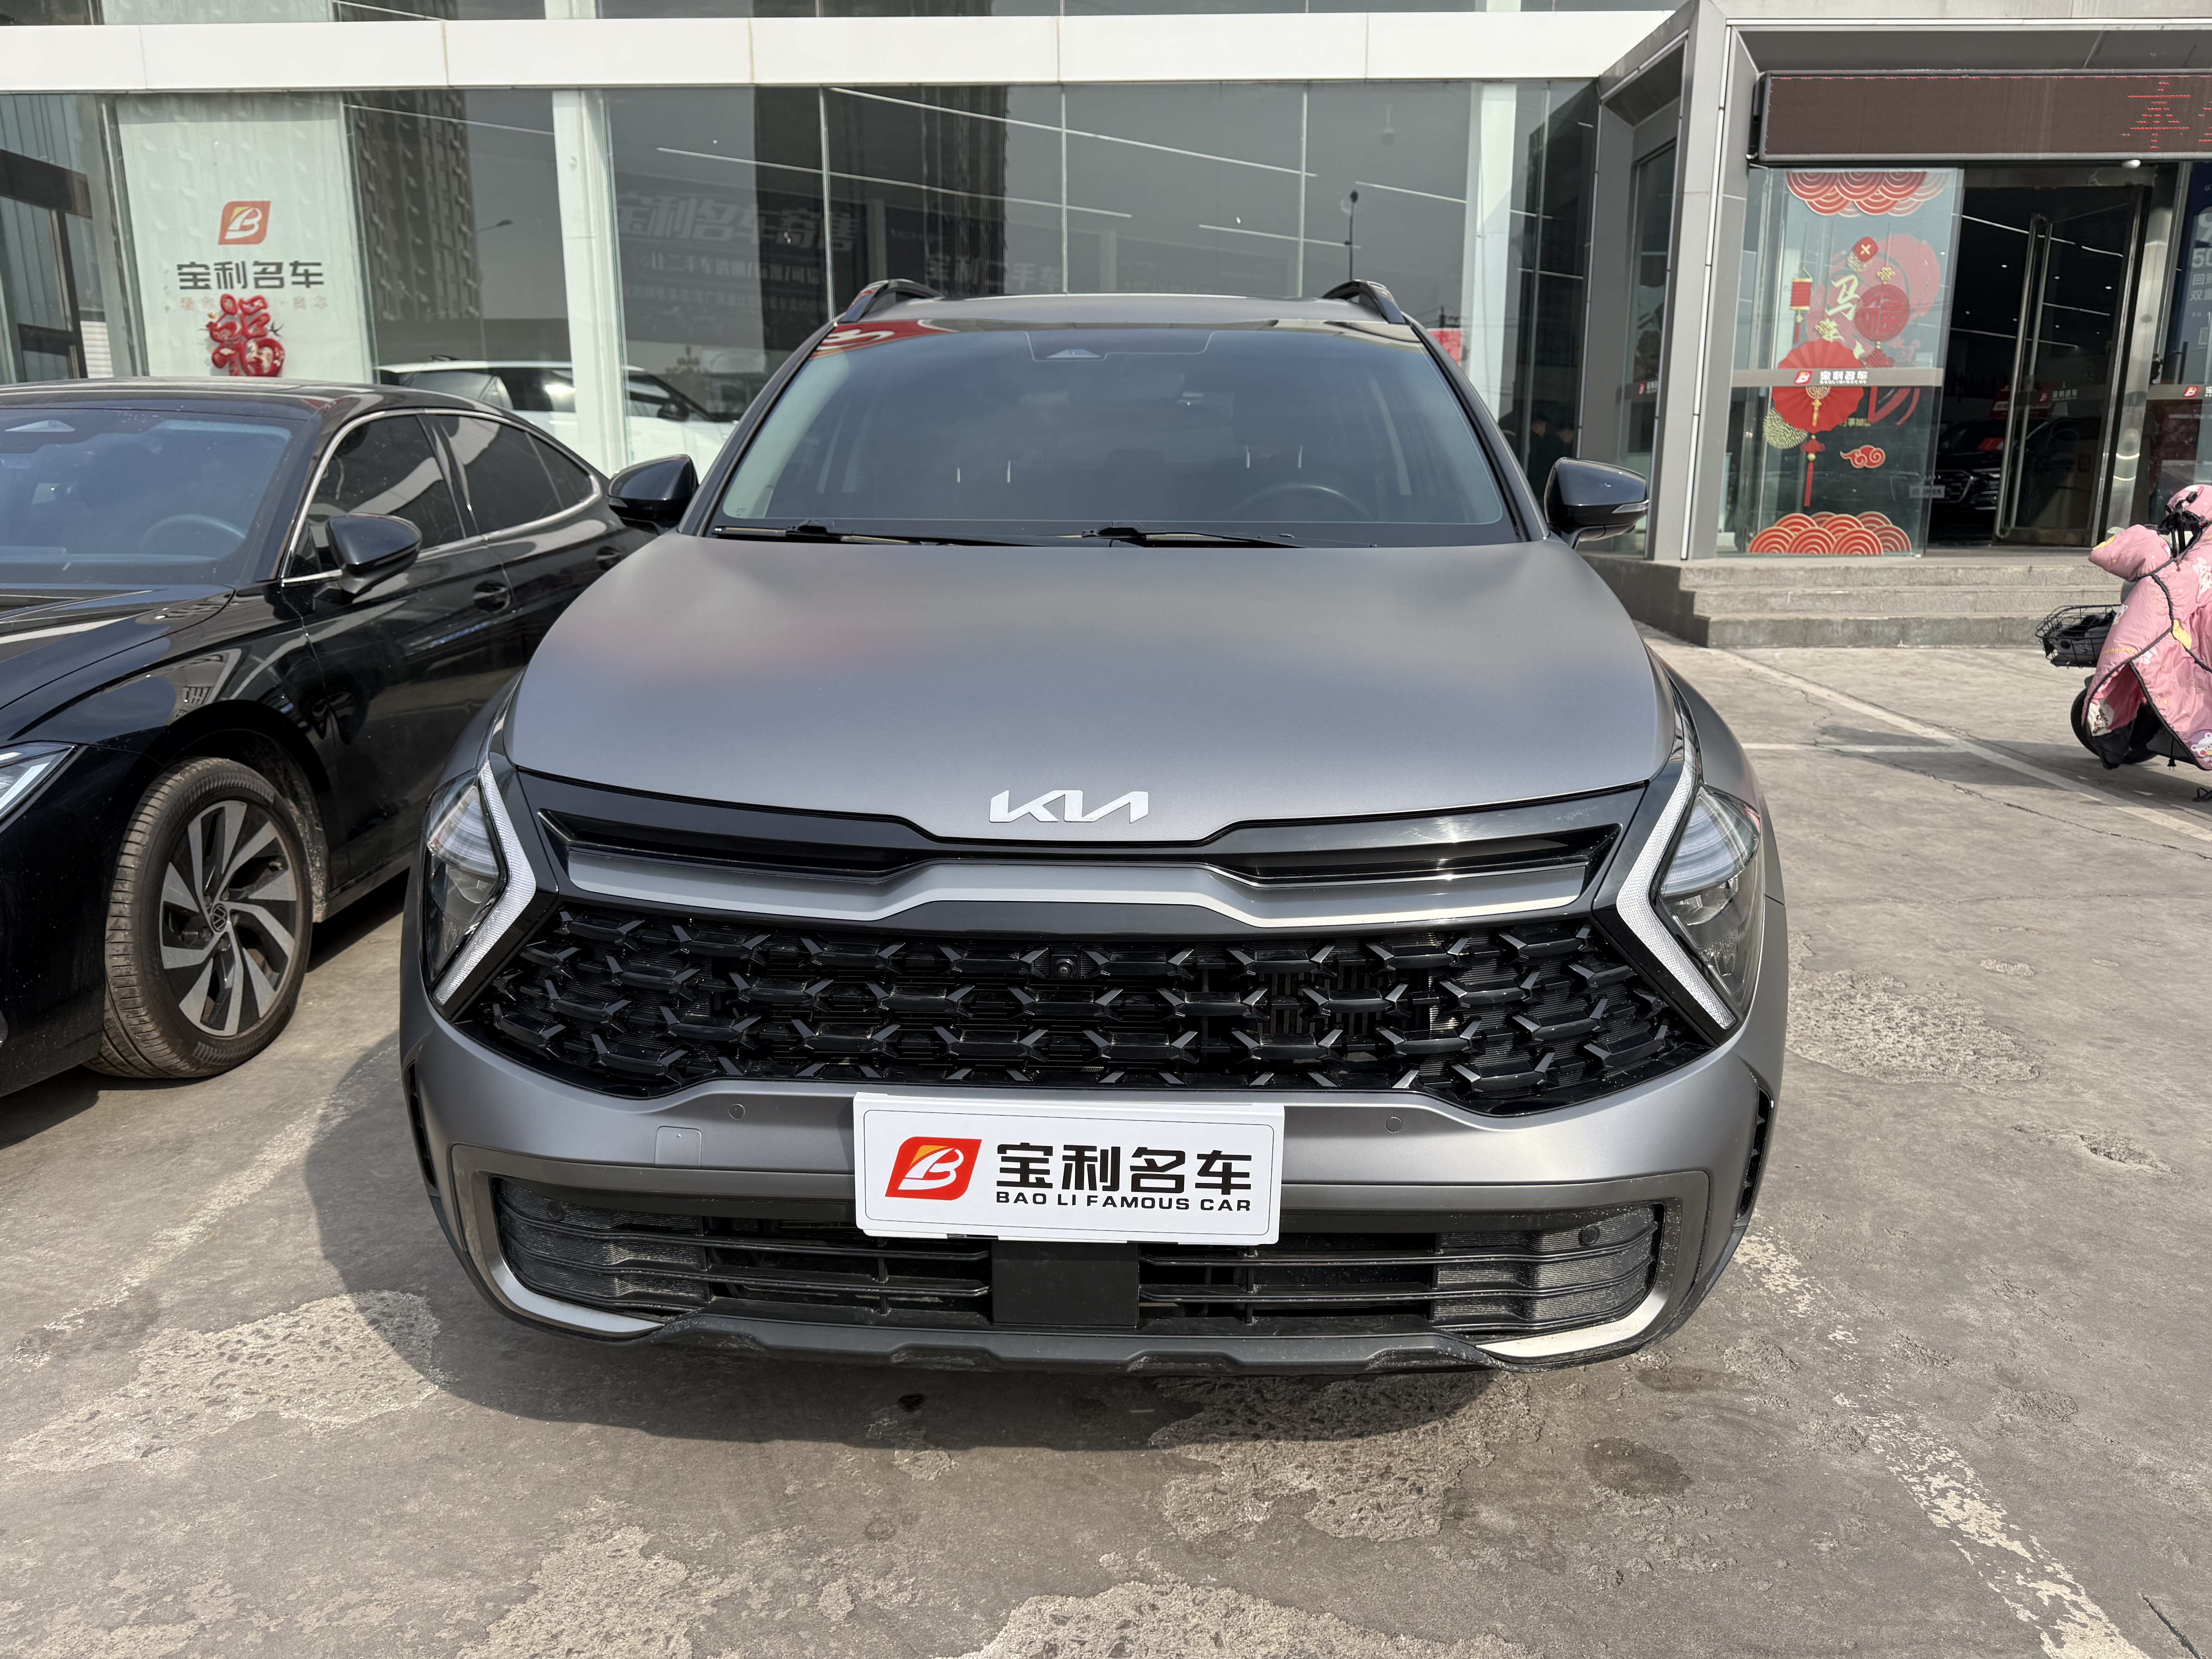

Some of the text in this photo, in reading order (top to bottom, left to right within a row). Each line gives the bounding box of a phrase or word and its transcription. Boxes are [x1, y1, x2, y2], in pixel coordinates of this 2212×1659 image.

[177, 260, 325, 290] 宝利名车
[989, 790, 1149, 823] KIA
[996, 1142, 1252, 1195] 宝利名车
[996, 1191, 1250, 1211] BAO LI FAMOUS CAR
